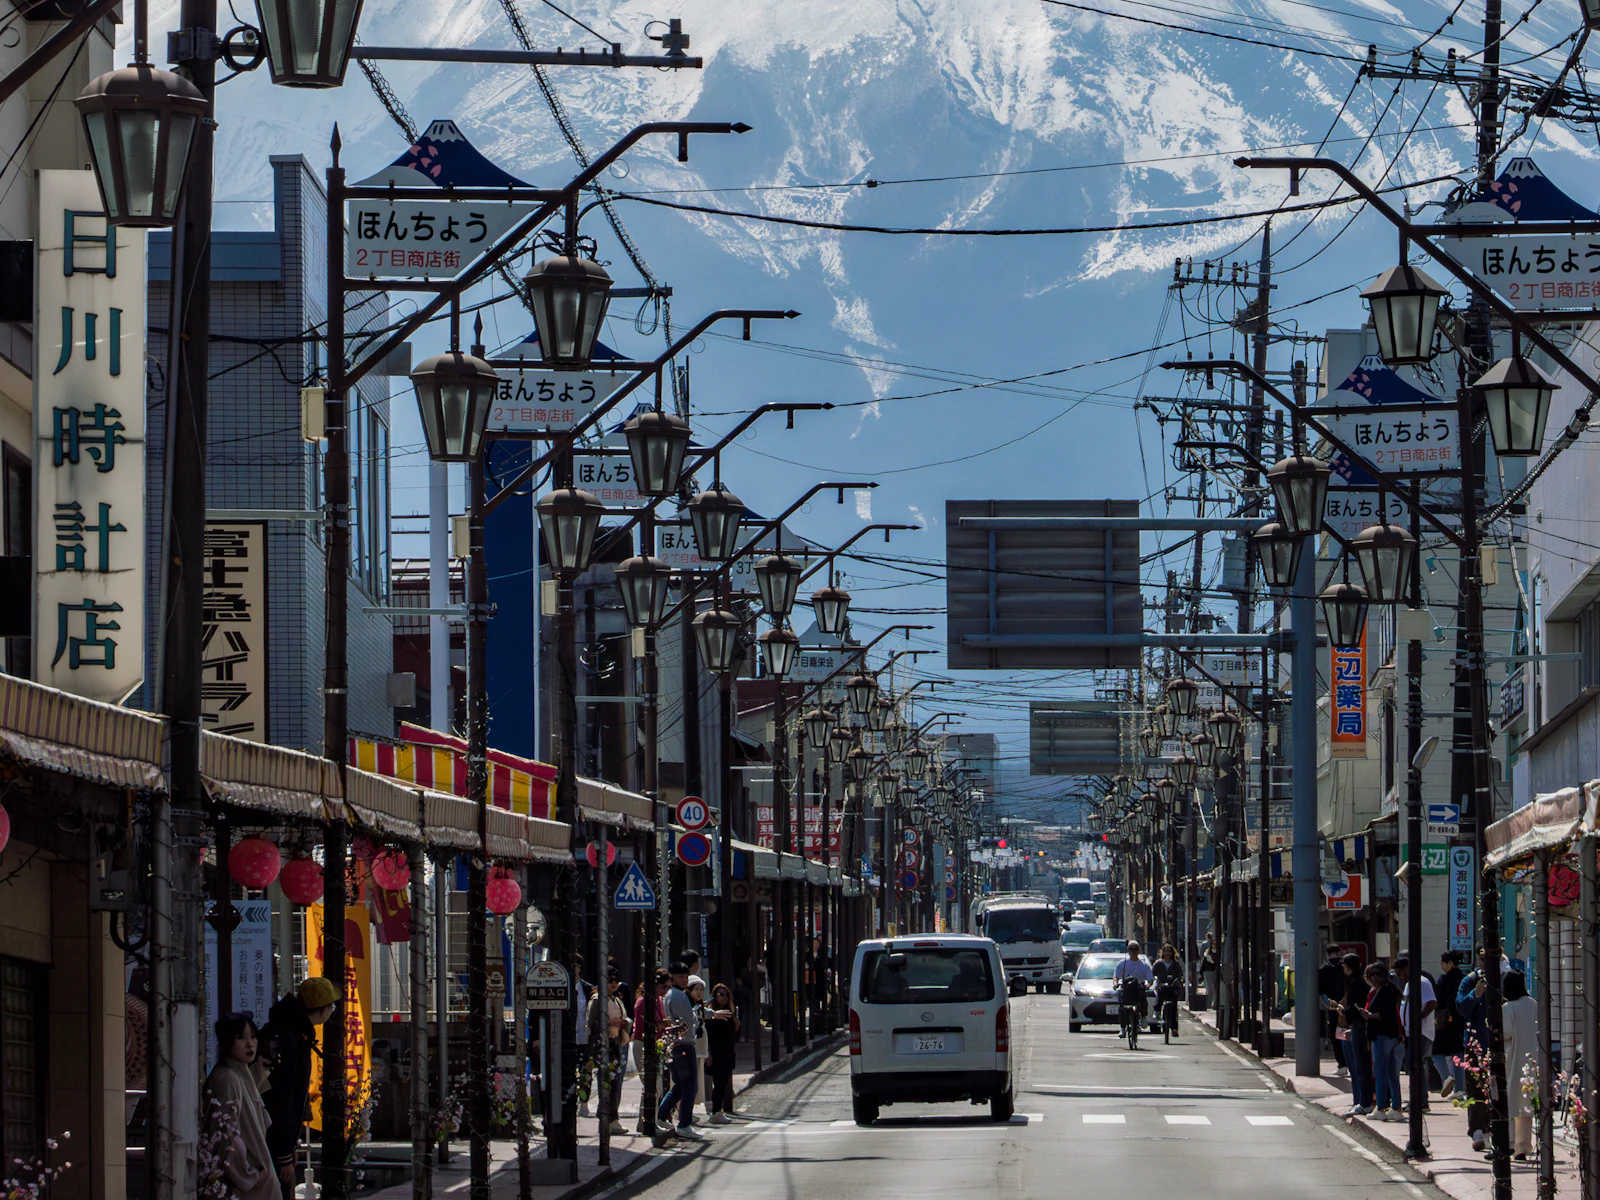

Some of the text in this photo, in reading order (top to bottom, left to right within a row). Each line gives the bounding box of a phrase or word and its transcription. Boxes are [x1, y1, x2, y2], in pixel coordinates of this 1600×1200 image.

[356, 210, 489, 244] ほんちょう
[355, 249, 461, 270] 2丁目商店街
[1482, 243, 1600, 275] ほんちょう
[494, 377, 596, 404] ほんちょう
[494, 407, 575, 423] 2丁目商店街
[52, 207, 126, 670] 日川時計店
[1355, 417, 1450, 446] ほんちょう
[1375, 447, 1451, 464] 2丁目商店街
[579, 462, 636, 483] ほんち
[1335, 646, 1362, 737] 辺薬局
[683, 804, 703, 822] 40
[1455, 869, 1468, 923] 渡辺歯科
[919, 1040, 943, 1050] 26-76
